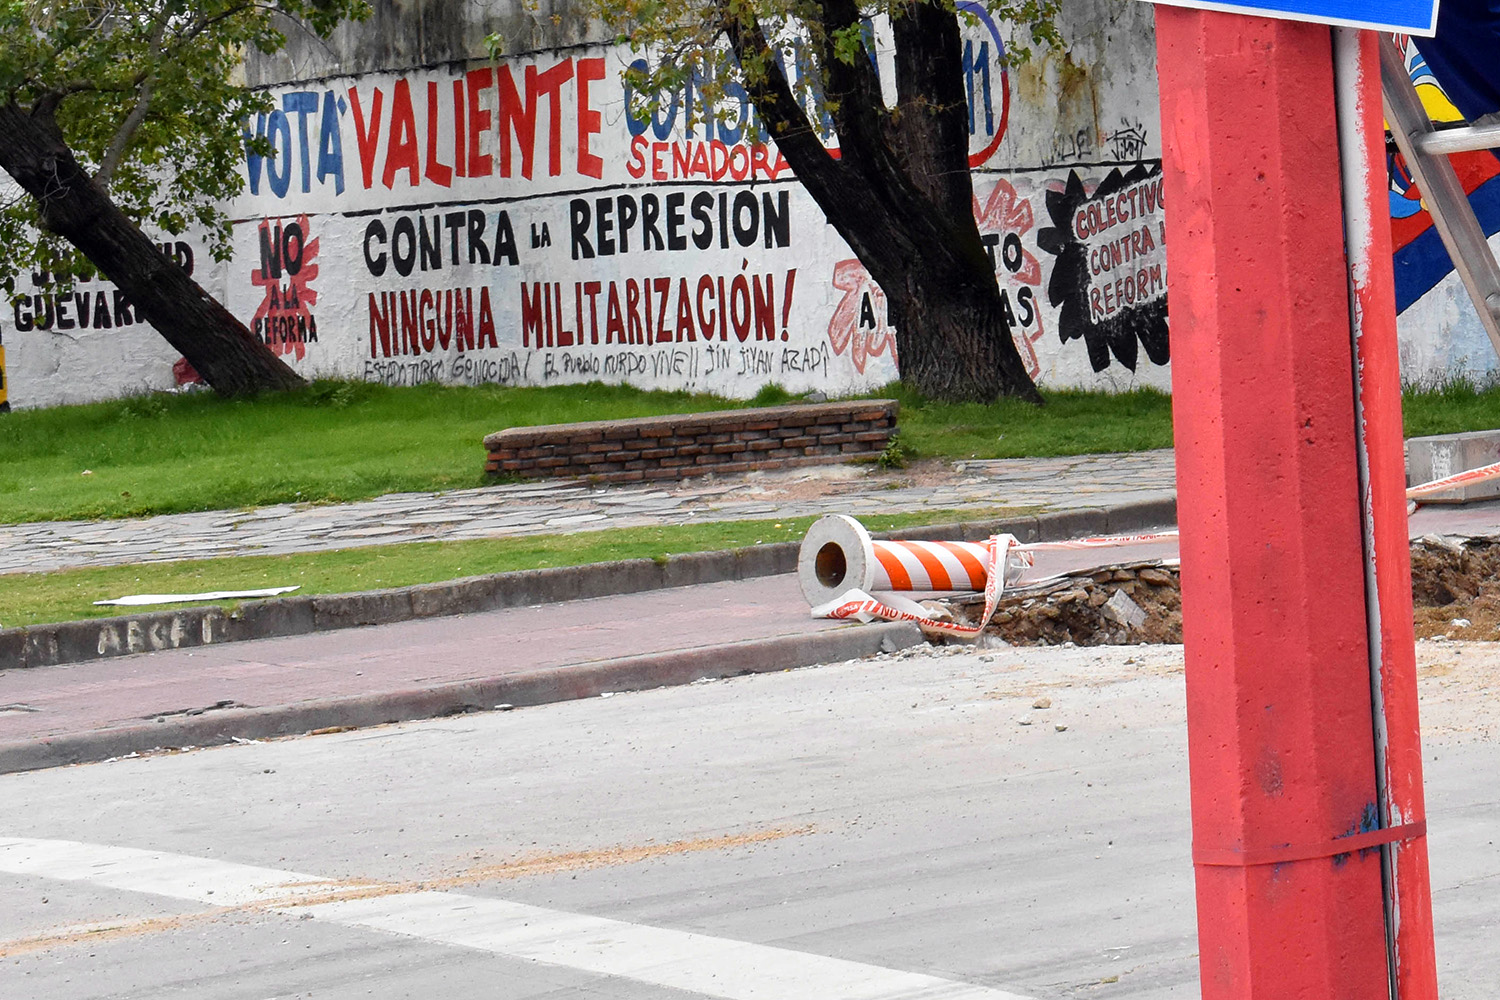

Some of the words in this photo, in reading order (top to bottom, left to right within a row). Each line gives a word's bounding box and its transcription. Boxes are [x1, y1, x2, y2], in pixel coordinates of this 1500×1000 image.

[348, 56, 605, 190] VALIENTE
[260, 223, 304, 279] NO
[363, 210, 519, 277] CONTRA
[530, 221, 551, 250] LA
[1090, 225, 1155, 276] CONTRA
[15, 289, 146, 331] GUEVAR
[270, 285, 280, 310] A
[283, 284, 299, 309] LA
[368, 286, 499, 358] NINGUNA
[521, 259, 797, 349] MILITARIZACIÓN!
[1090, 263, 1169, 320] REFORM
[254, 315, 318, 345] REFORMA
